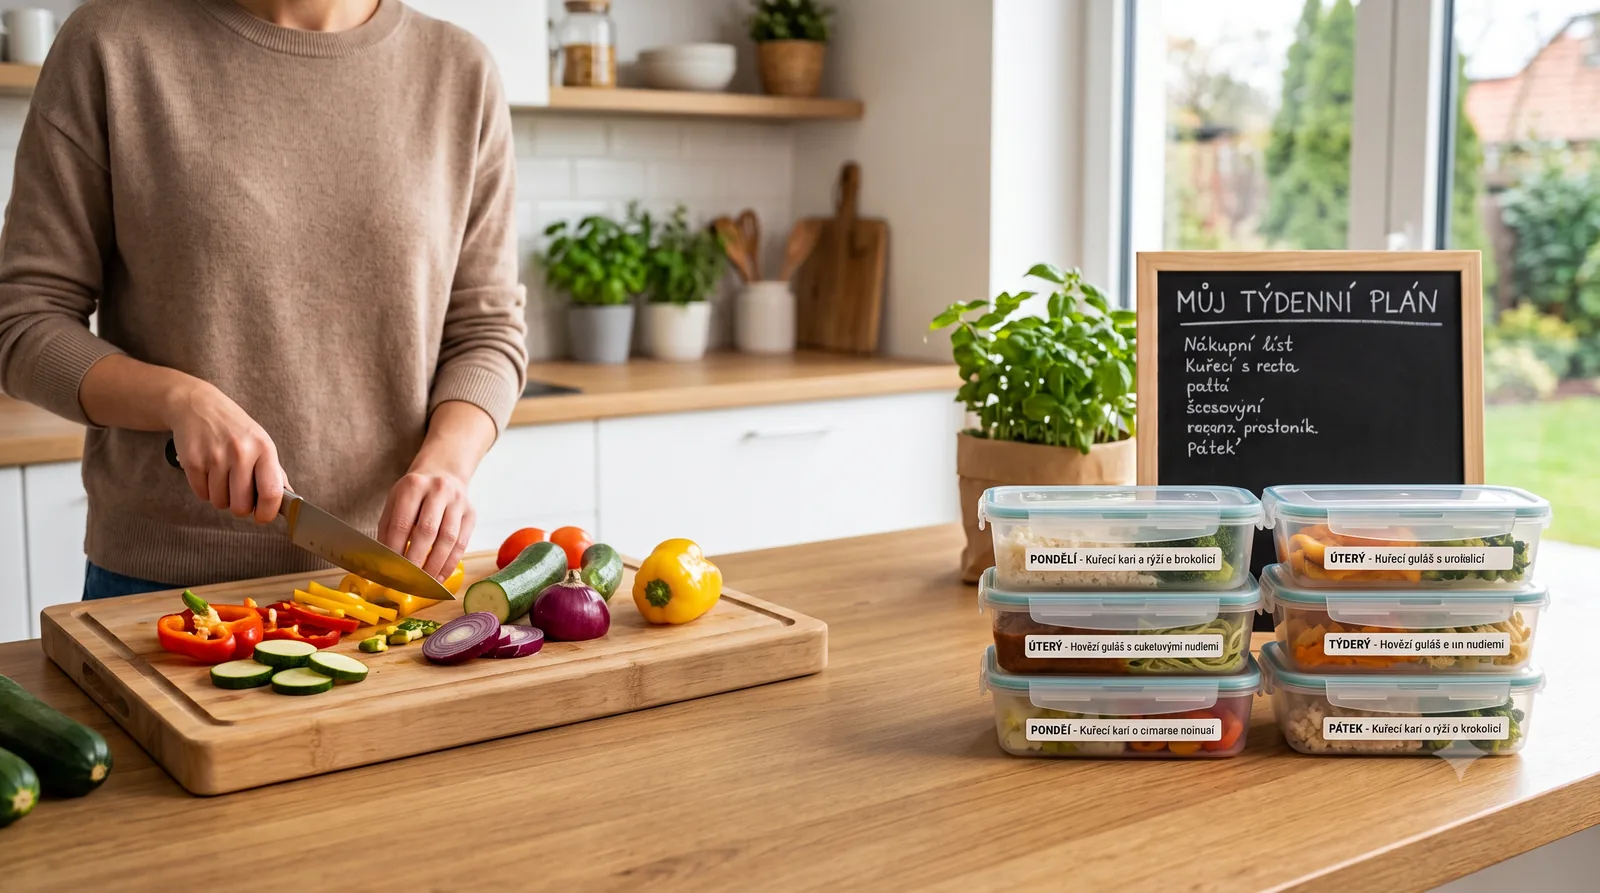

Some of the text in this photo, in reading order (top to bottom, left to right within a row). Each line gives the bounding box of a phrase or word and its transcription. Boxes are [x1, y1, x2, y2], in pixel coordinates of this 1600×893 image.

[1178, 281, 1438, 313] MŮJ TÝDENNÍ PLÁN
[1184, 334, 1256, 357] Nákupní
[1185, 357, 1300, 373] Kuřecí s recta
[1031, 551, 1078, 565] PONDĚLÍ
[1086, 553, 1117, 565] Kuřecí
[1139, 556, 1145, 565] a
[1147, 553, 1164, 567] rýží
[1166, 556, 1173, 565] e
[1175, 553, 1216, 564] brokolicí
[1331, 551, 1366, 564] ÚTERÝ
[1408, 553, 1434, 566] guláš
[1437, 555, 1443, 564] s
[1029, 639, 1063, 652] ÚTERÝ
[1070, 641, 1100, 652] Hovězí
[1101, 641, 1125, 654] guláš
[1127, 643, 1132, 652] s
[1185, 641, 1219, 652] nudlemi
[1329, 636, 1372, 650] TÝDERÝ
[1381, 638, 1413, 650] Hovězí
[1415, 638, 1441, 652] guláš
[1444, 641, 1450, 650] e
[1031, 723, 1072, 736] PONDĚÍ
[1080, 724, 1111, 736] Kuřecí
[1133, 727, 1139, 736] o
[1329, 721, 1364, 734] PÁTEK
[1372, 723, 1403, 734] Kuřecí
[1425, 725, 1431, 734] o
[1433, 723, 1451, 736] rýží
[1453, 725, 1459, 734] o
